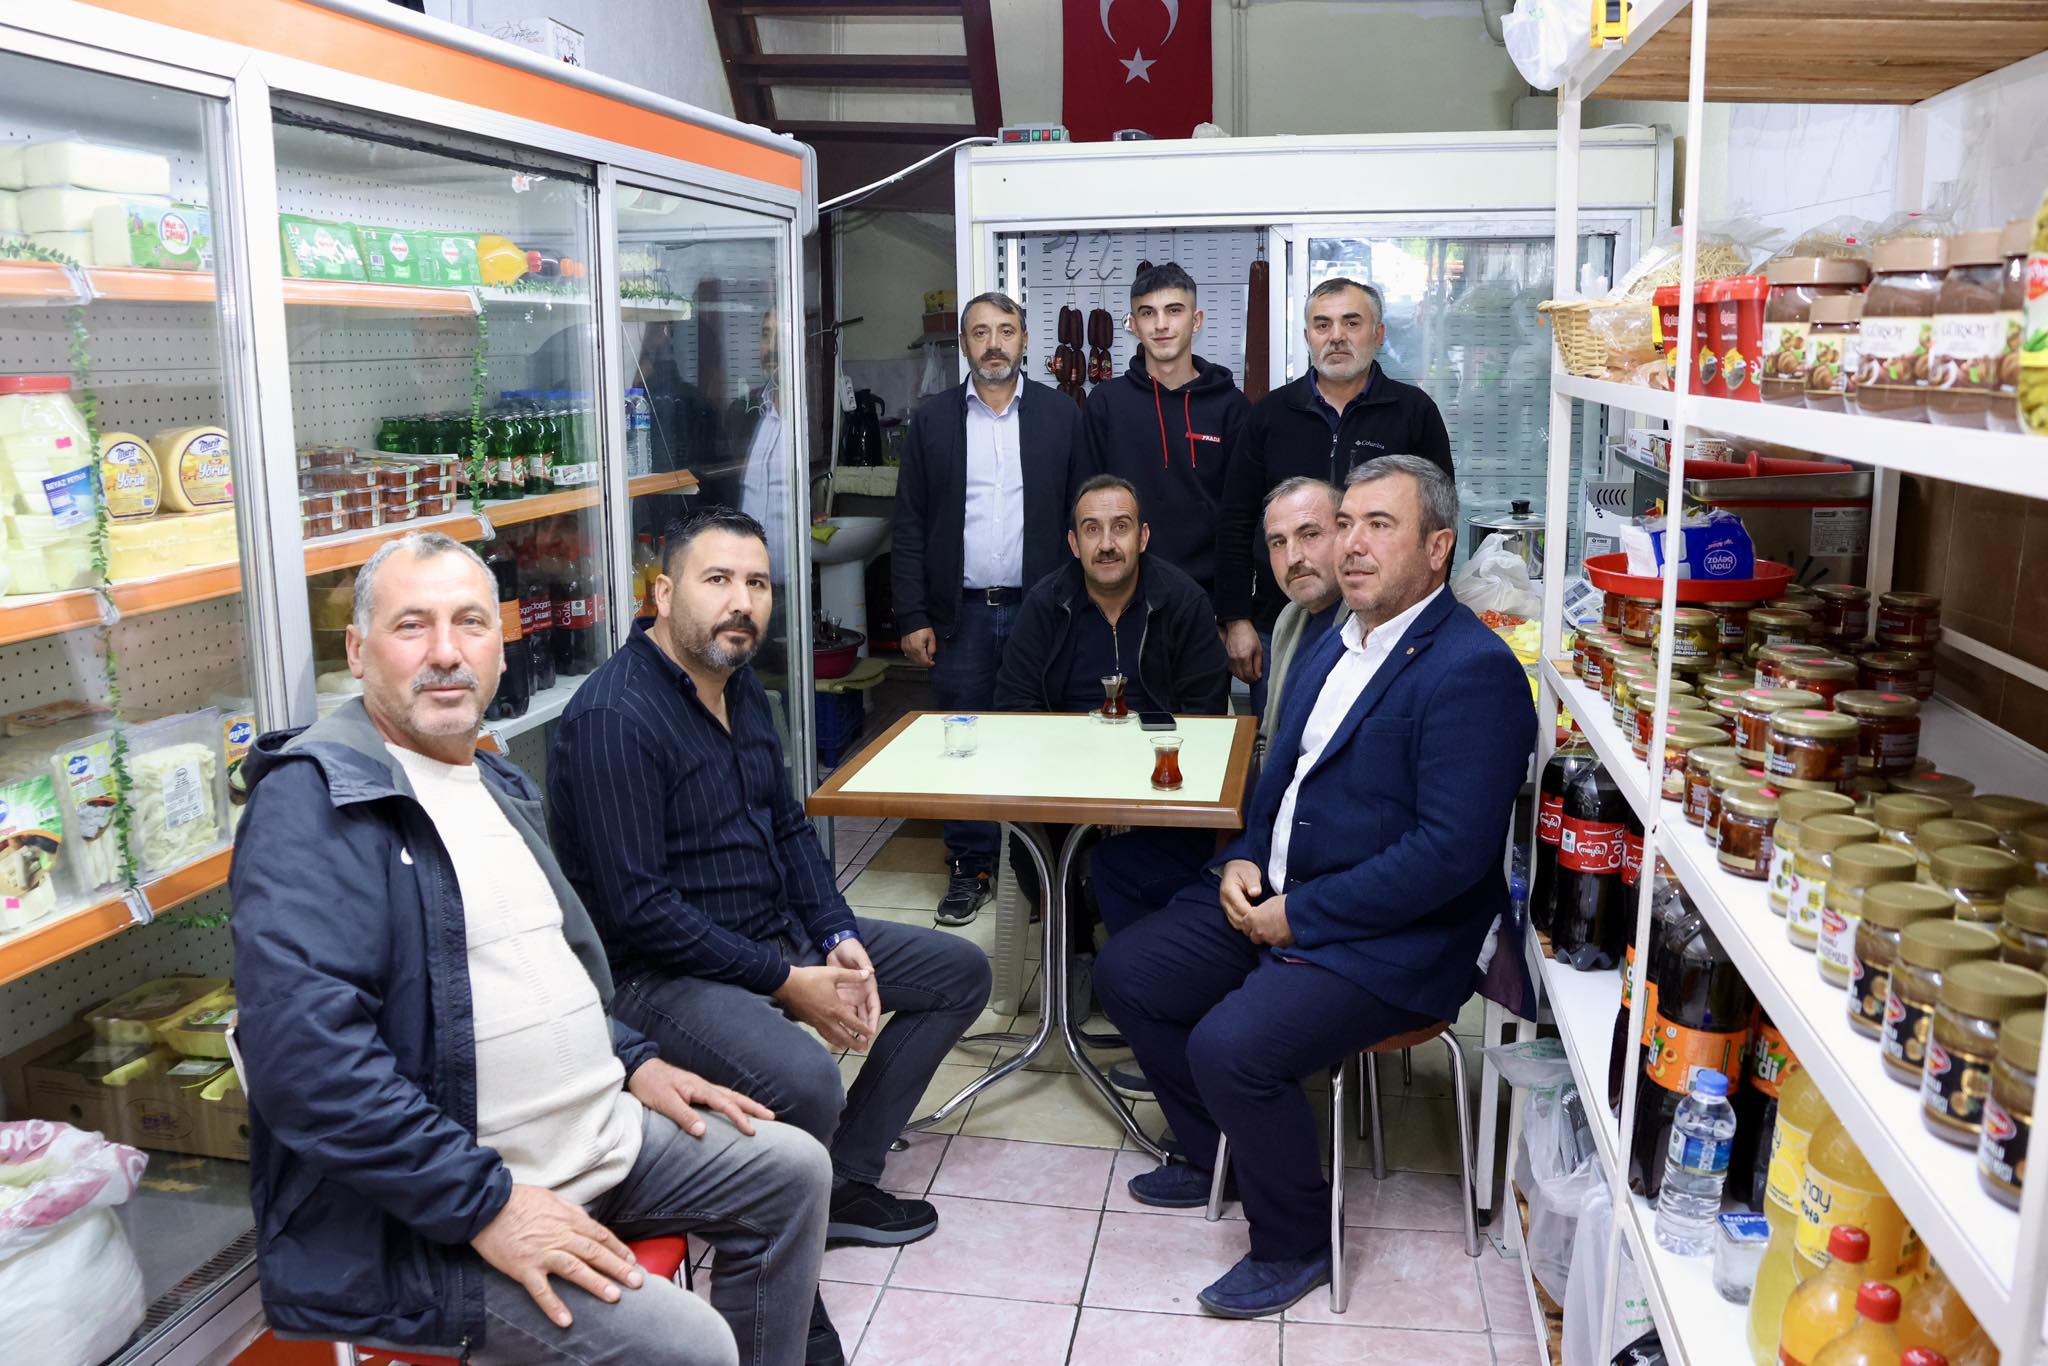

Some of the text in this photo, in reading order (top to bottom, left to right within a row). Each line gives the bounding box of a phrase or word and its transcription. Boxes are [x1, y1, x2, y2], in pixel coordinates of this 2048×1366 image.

[1707, 555, 1734, 566] beyaz
[1710, 563, 1731, 571] mavi
[562, 601, 571, 625] Cola
[1608, 829, 1624, 868] Cola
[1756, 1034, 1769, 1061] di
[1758, 1056, 1780, 1084] di
